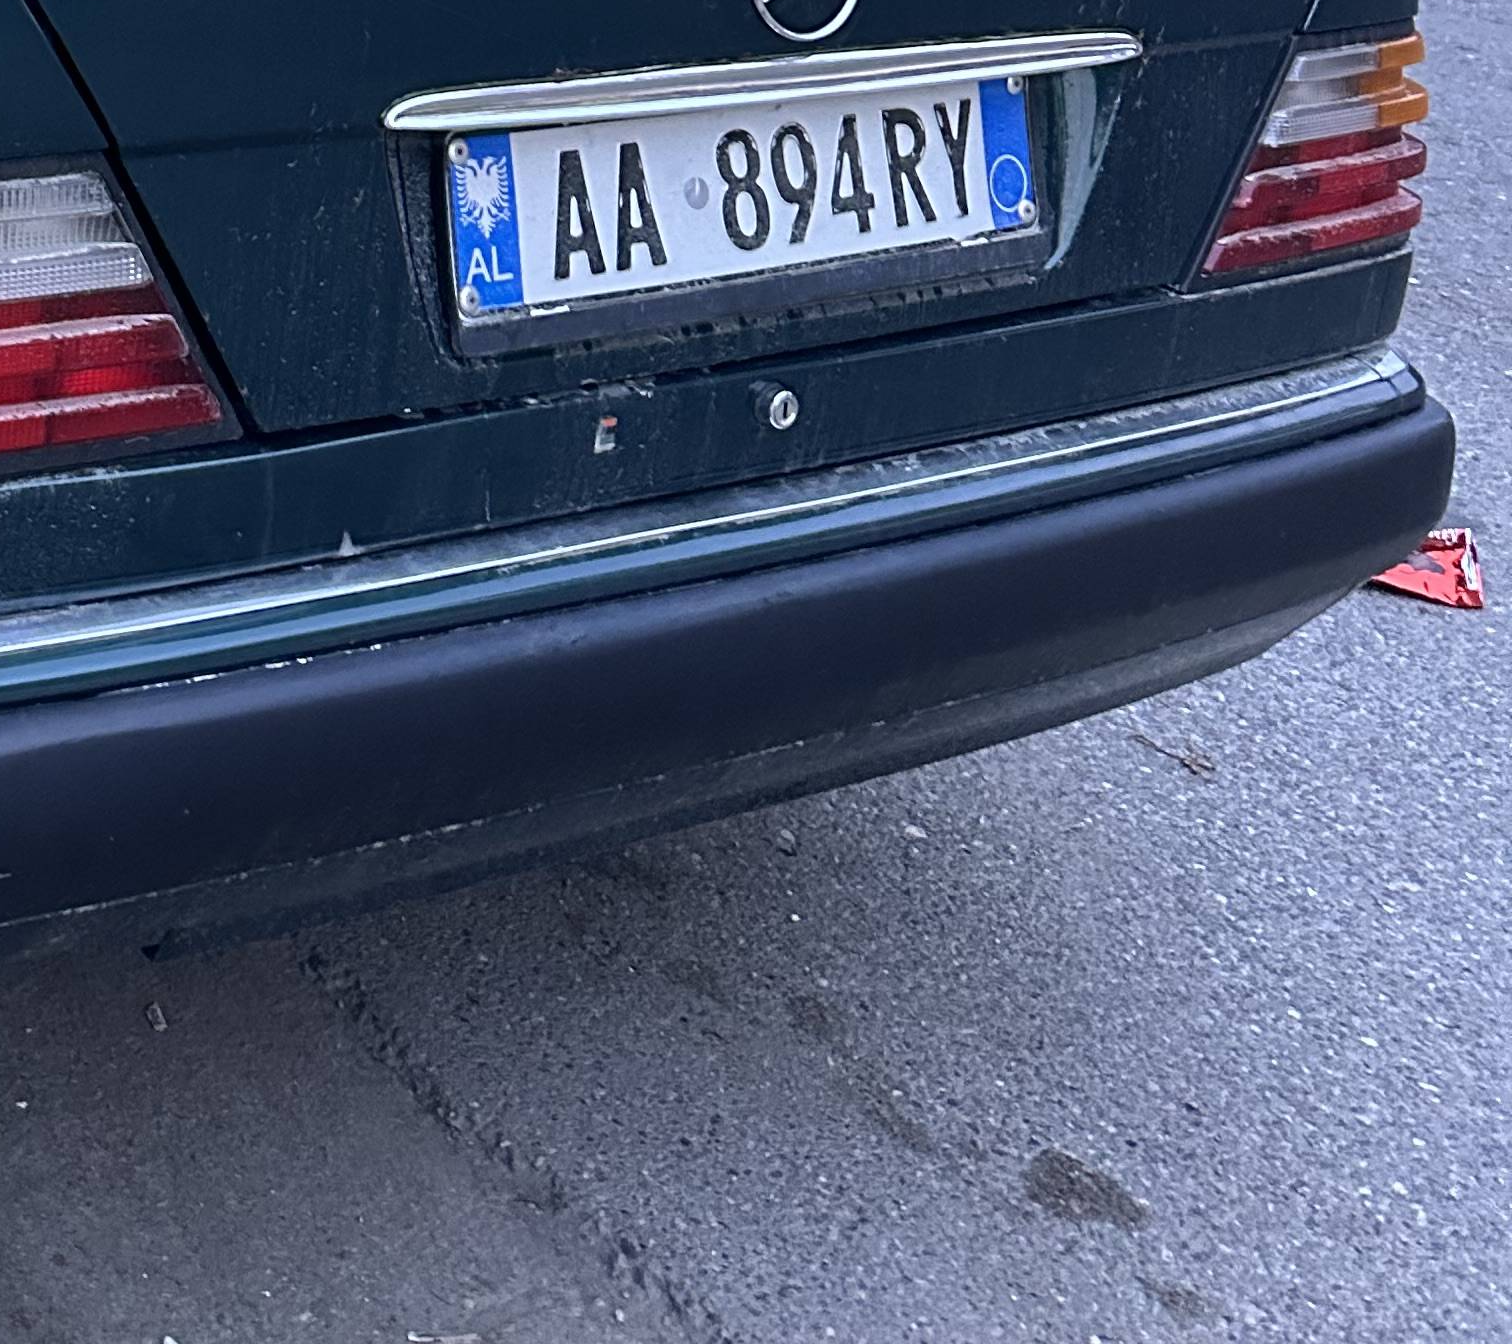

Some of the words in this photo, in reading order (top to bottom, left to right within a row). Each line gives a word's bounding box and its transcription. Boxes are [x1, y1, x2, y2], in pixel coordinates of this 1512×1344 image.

[554, 142, 667, 280] AA
[715, 98, 972, 251] 894RY
[466, 245, 514, 284] AL
